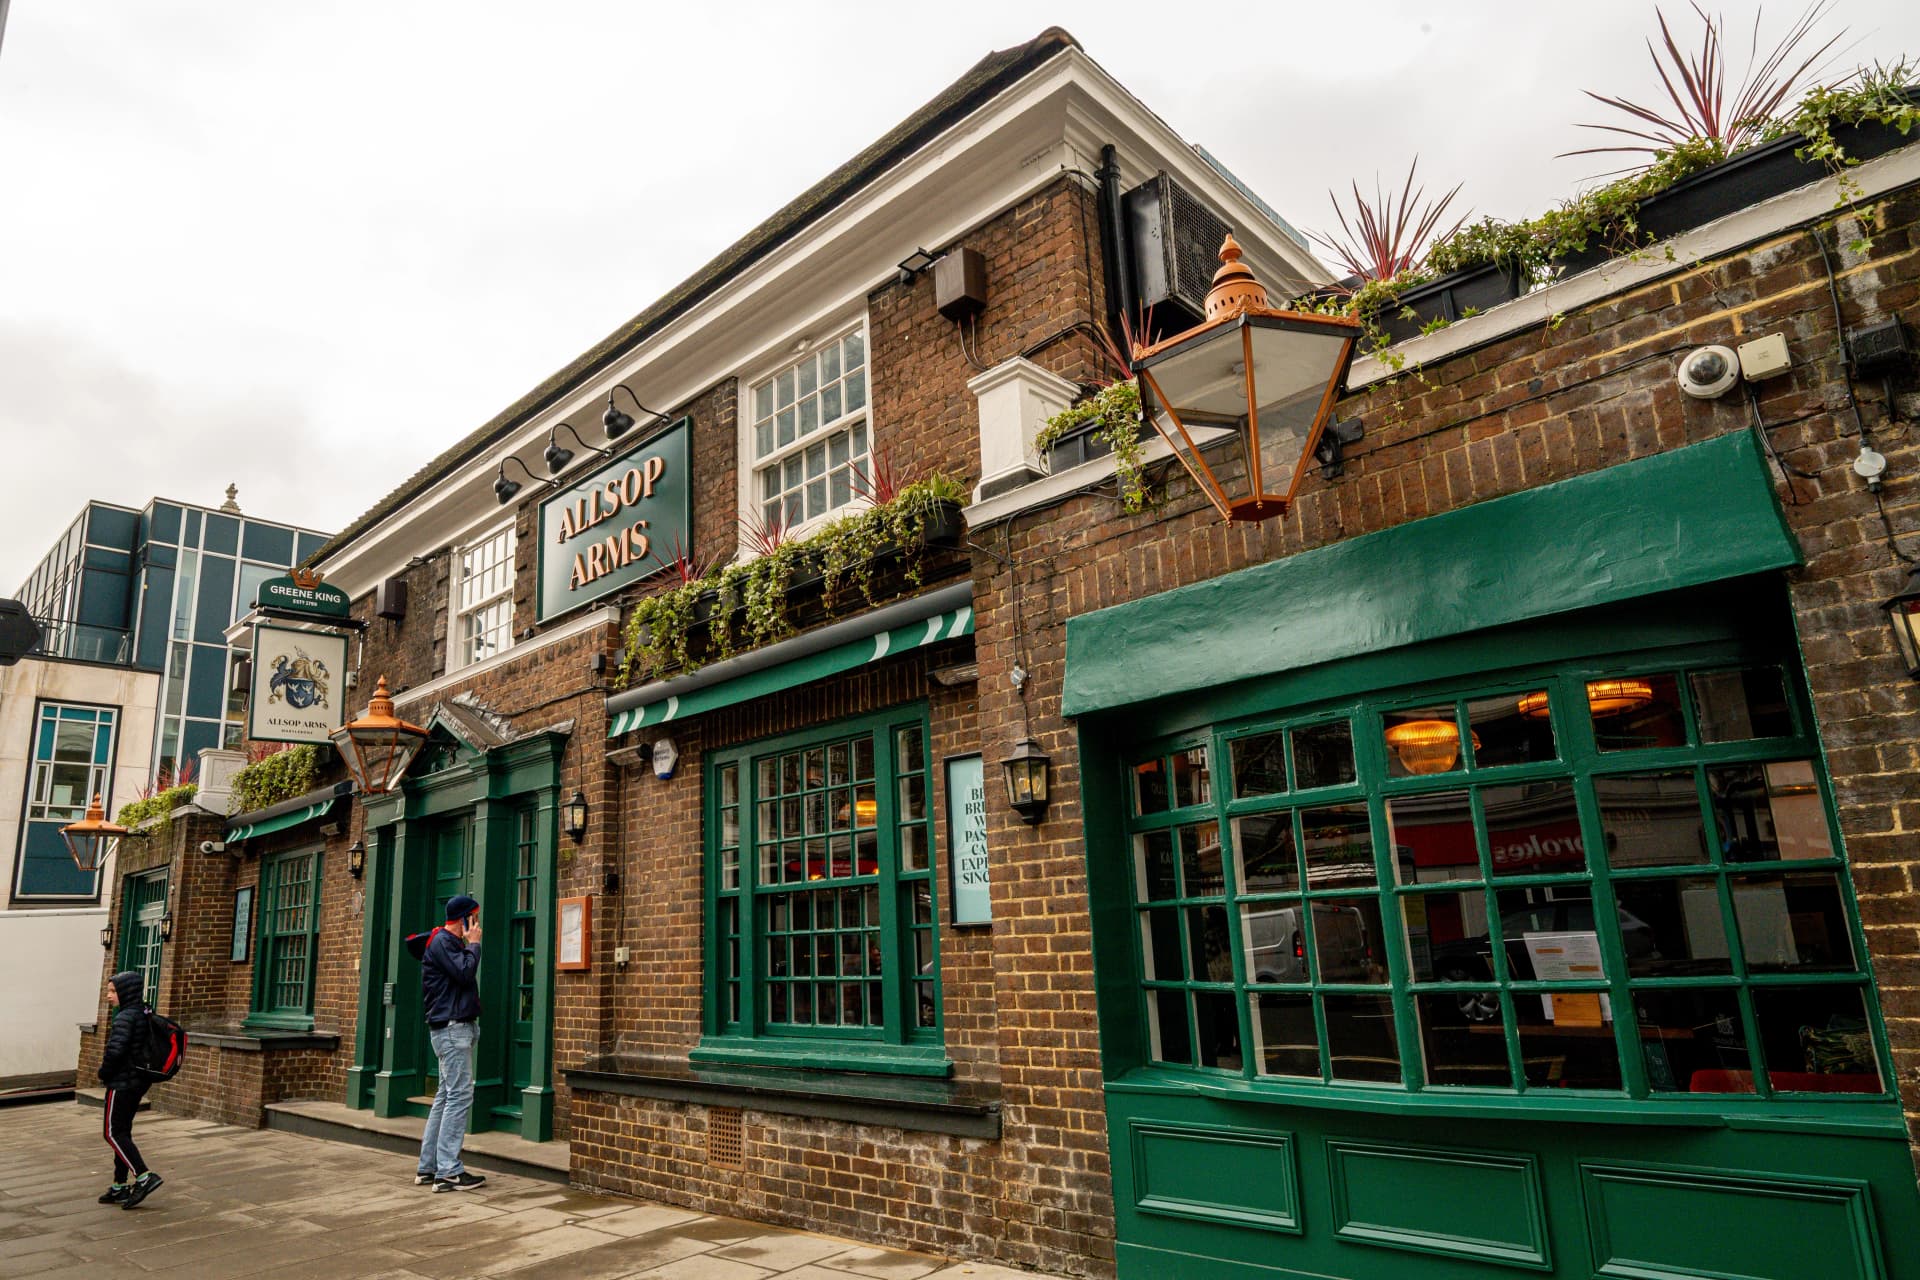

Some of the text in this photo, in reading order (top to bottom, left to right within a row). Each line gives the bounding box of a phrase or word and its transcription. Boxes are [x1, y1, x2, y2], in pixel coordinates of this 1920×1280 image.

[556, 456, 665, 544] ALLSOP
[569, 520, 649, 591] ARMS
[270, 585, 342, 604] GREENE KING
[267, 717, 328, 729] ALLSOP ARMS
[965, 829, 987, 842] PAS
[971, 843, 987, 856] CA
[962, 871, 989, 885] SINC
